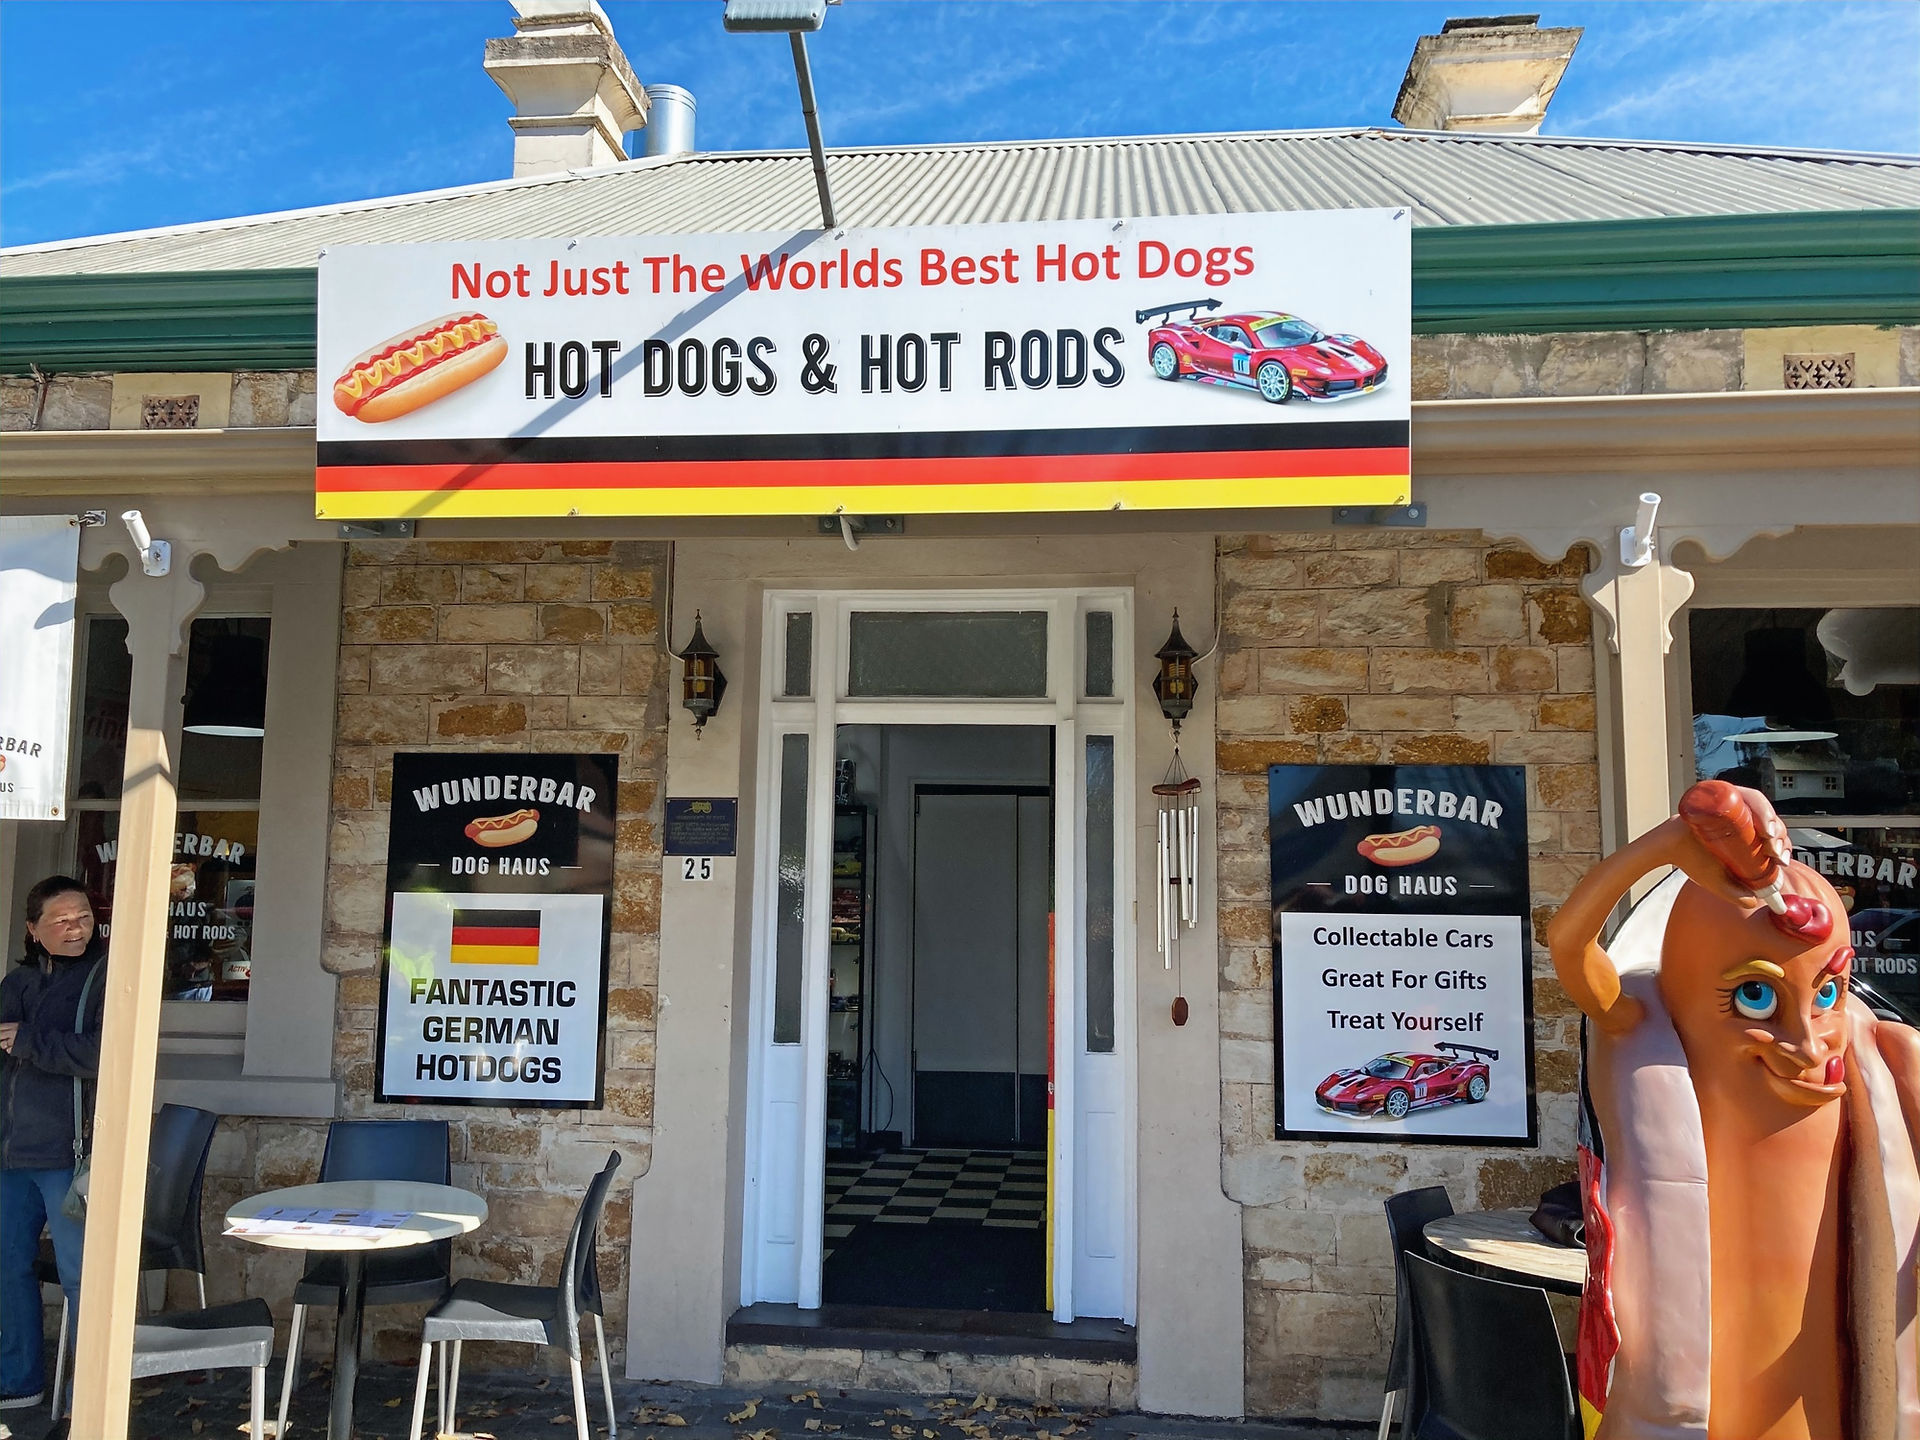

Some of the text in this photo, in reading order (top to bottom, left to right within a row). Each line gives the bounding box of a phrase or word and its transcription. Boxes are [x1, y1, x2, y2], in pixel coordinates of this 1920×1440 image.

[452, 240, 1255, 300] Not Just The Worlds Best Hot Dogs
[525, 326, 1125, 400] HOT DOGS & HOT RODS
[413, 775, 597, 813] WUNDERBAR
[1293, 788, 1504, 830] WUNDERBAR
[451, 856, 551, 876] DOG HAUS
[685, 857, 711, 880] 25
[1797, 851, 1918, 889] DERBAR
[1345, 875, 1458, 896] DOG HAUS
[174, 924, 236, 940] HOT RODS
[1313, 926, 1494, 948] Collectable Cars
[1851, 930, 1876, 948] US
[1850, 957, 1918, 974] OT RODS
[1321, 968, 1487, 990] Great For Gifts
[410, 978, 577, 1008] FANTASTIC
[422, 1016, 560, 1046] GERMAN
[1327, 1010, 1484, 1032] Treat Yourself
[416, 1054, 562, 1084] HOTDOGS
